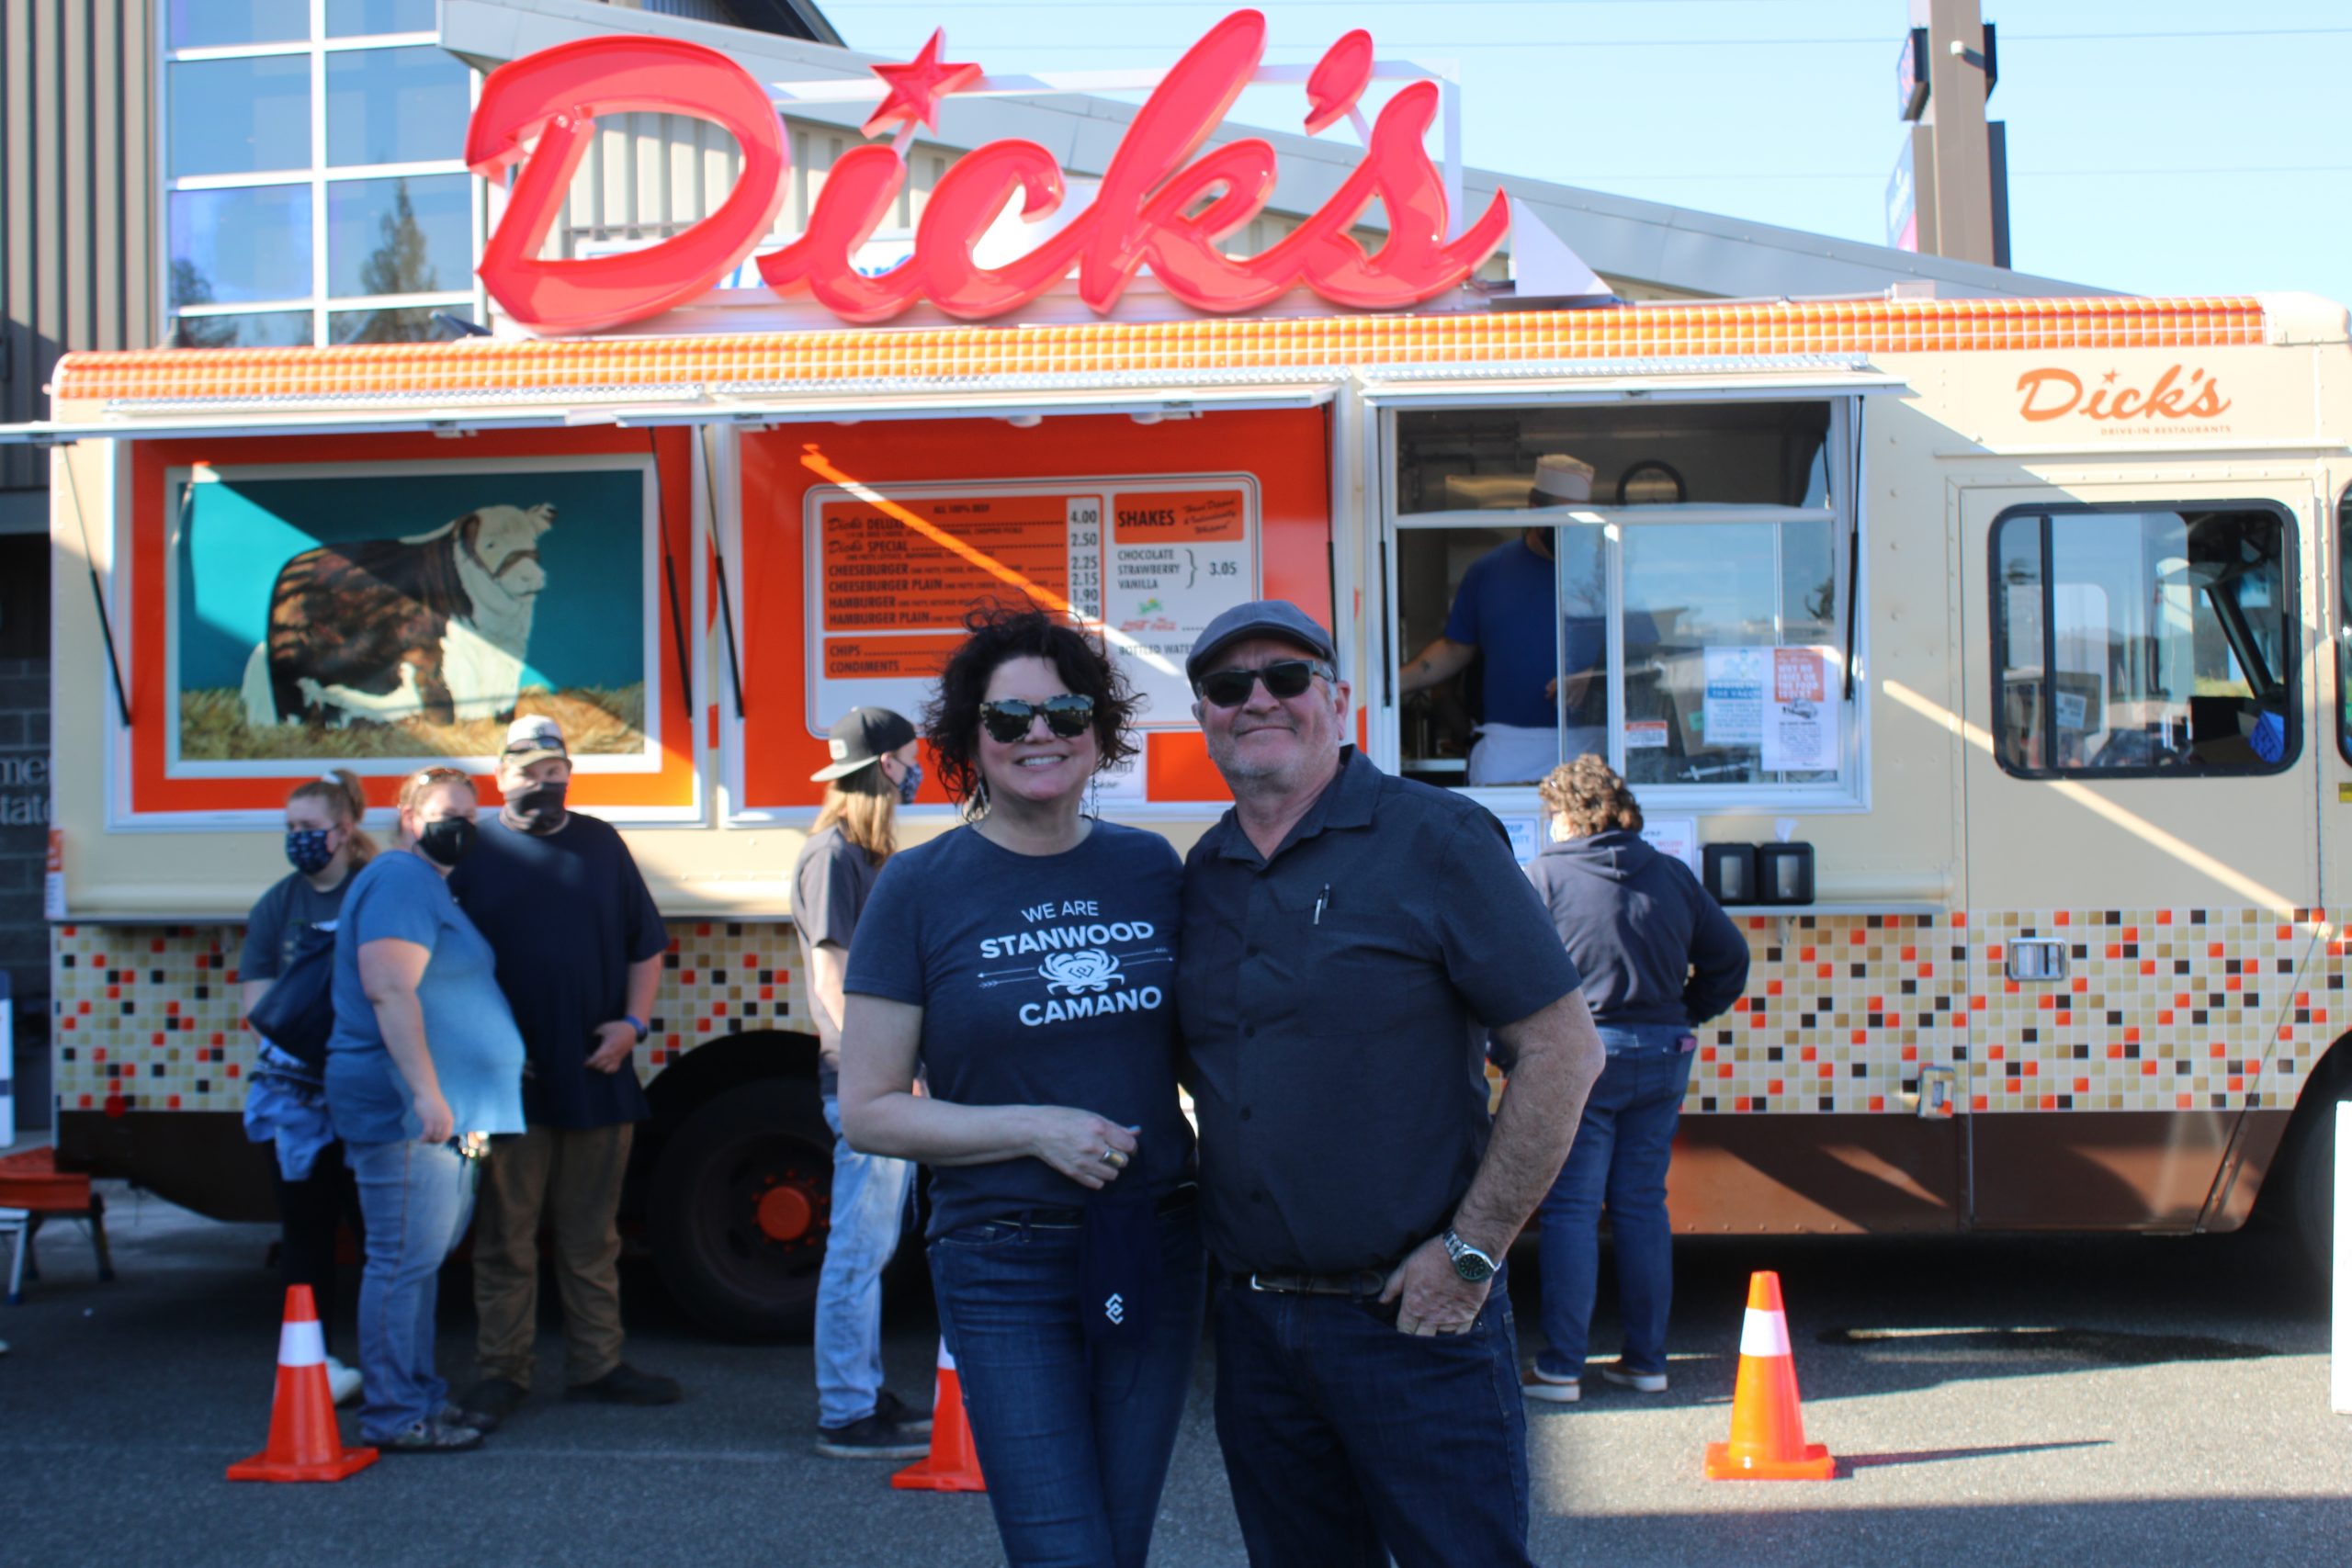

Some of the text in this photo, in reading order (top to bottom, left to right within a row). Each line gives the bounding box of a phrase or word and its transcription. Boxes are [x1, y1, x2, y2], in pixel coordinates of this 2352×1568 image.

[465, 8, 1512, 333] Dick's
[2017, 363, 2233, 423] Dick's
[2100, 424, 2232, 436] DRIVE-IN RESTAURANTS
[828, 516, 905, 532] Dick's DELUXE
[1070, 510, 1098, 525] 4.00
[1117, 509, 1176, 528] SHAKES
[828, 539, 908, 555] Dick's SPECIAL
[1070, 533, 1098, 547] 2.50
[1117, 548, 1175, 561] CHOCOLATE
[1070, 556, 1098, 570] 2.25
[1117, 563, 1181, 576] STRAWBERRY
[829, 564, 909, 577] CHEESEBURGER
[829, 580, 909, 592] CHEESEBURGER
[911, 579, 943, 590] PLAIN
[1070, 571, 1099, 587] 2.15
[1117, 579, 1159, 590] VANILLA
[829, 596, 896, 609] HAMBURGER
[1071, 588, 1099, 603] 1.90
[829, 612, 896, 626] HAMBURGER
[899, 612, 930, 624] PLAIN
[830, 645, 861, 658] CHIPS
[1118, 643, 1195, 656] BOTTLED WATE
[830, 660, 900, 673] CONDIMENTS
[1021, 900, 1100, 923] WE ARE
[979, 920, 1156, 959] STANWOOD
[1018, 985, 1163, 1027] CAMANO
